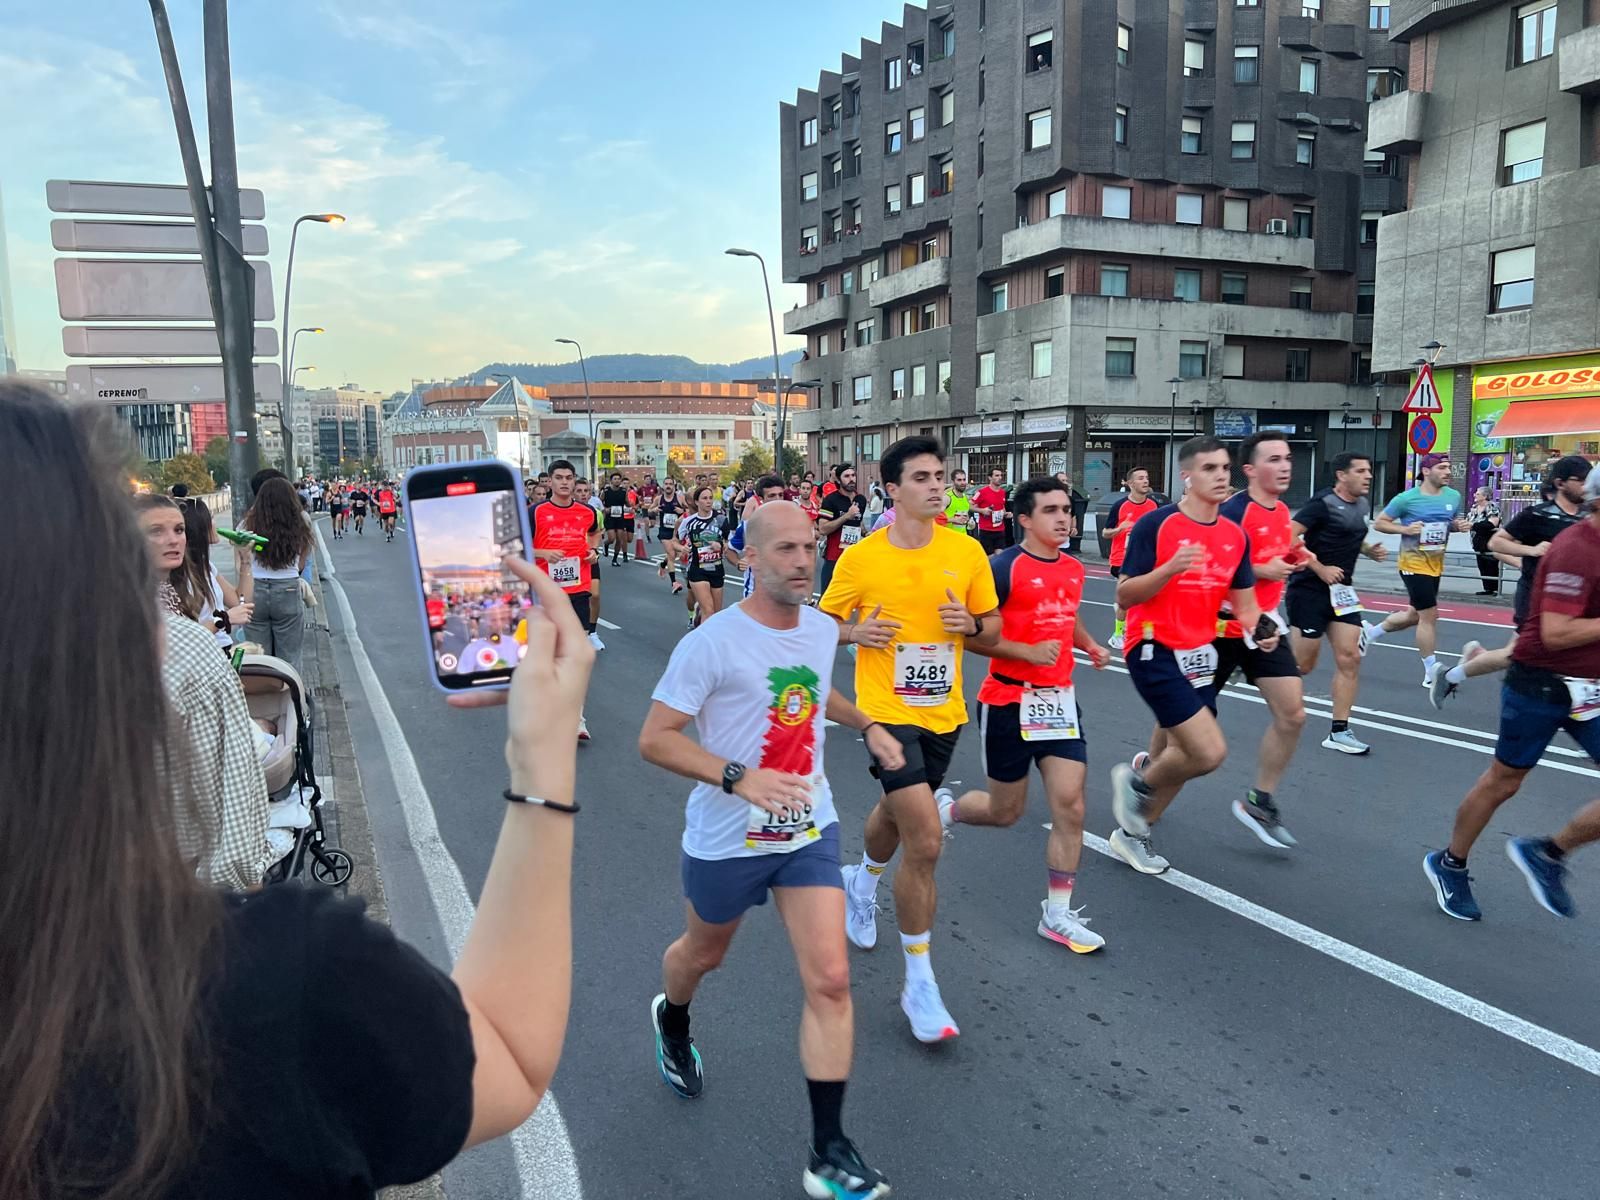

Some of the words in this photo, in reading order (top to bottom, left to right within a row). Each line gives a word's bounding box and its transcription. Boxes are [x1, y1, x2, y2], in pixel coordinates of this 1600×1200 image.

[553, 567, 574, 576] 3658
[1182, 653, 1209, 668] 2451
[905, 665, 947, 680] 3489
[1028, 703, 1064, 717] 3596
